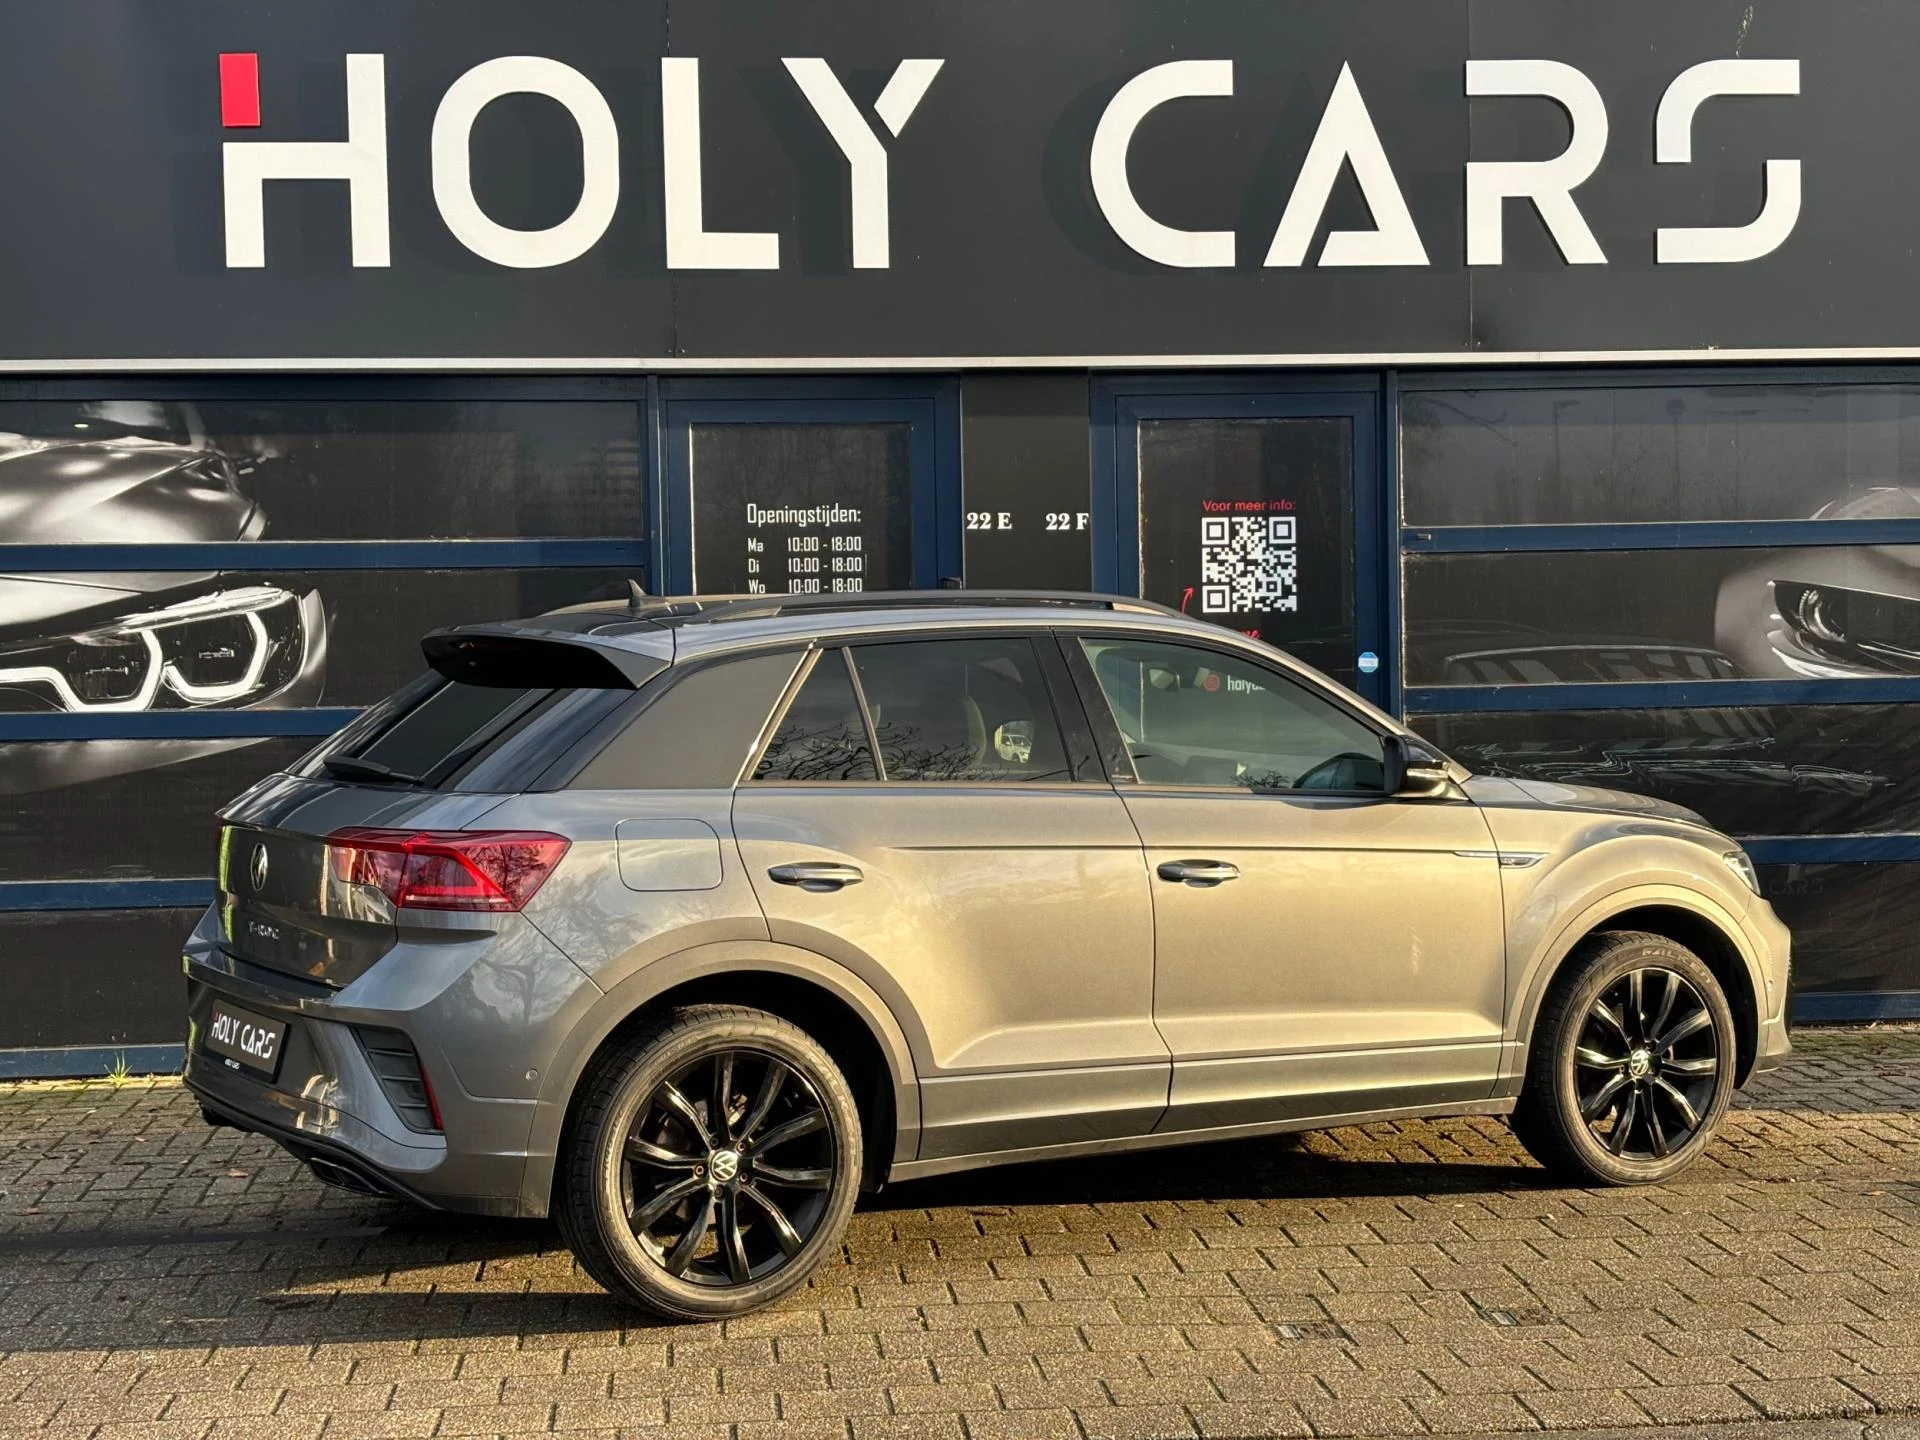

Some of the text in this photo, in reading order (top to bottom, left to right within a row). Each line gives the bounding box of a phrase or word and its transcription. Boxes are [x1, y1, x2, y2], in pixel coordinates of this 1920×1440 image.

[219, 53, 1801, 270] HOLY CARS
[1202, 499, 1296, 511] Voor meer info:
[746, 502, 862, 528] Openingstijden:
[966, 512, 1013, 530] 22 E
[1045, 512, 1090, 530] 22 F
[747, 537, 764, 552] Ma
[787, 536, 820, 552] 10:00
[831, 536, 862, 552] 18:00
[748, 558, 760, 573] Di
[788, 557, 820, 573] 10:00
[832, 557, 863, 572] 18:00
[748, 579, 766, 594] Wo
[788, 579, 820, 594] 10:00
[832, 578, 863, 593] 18:00
[1227, 674, 1265, 694] holy
[211, 1011, 276, 1059] HOLY CARS
